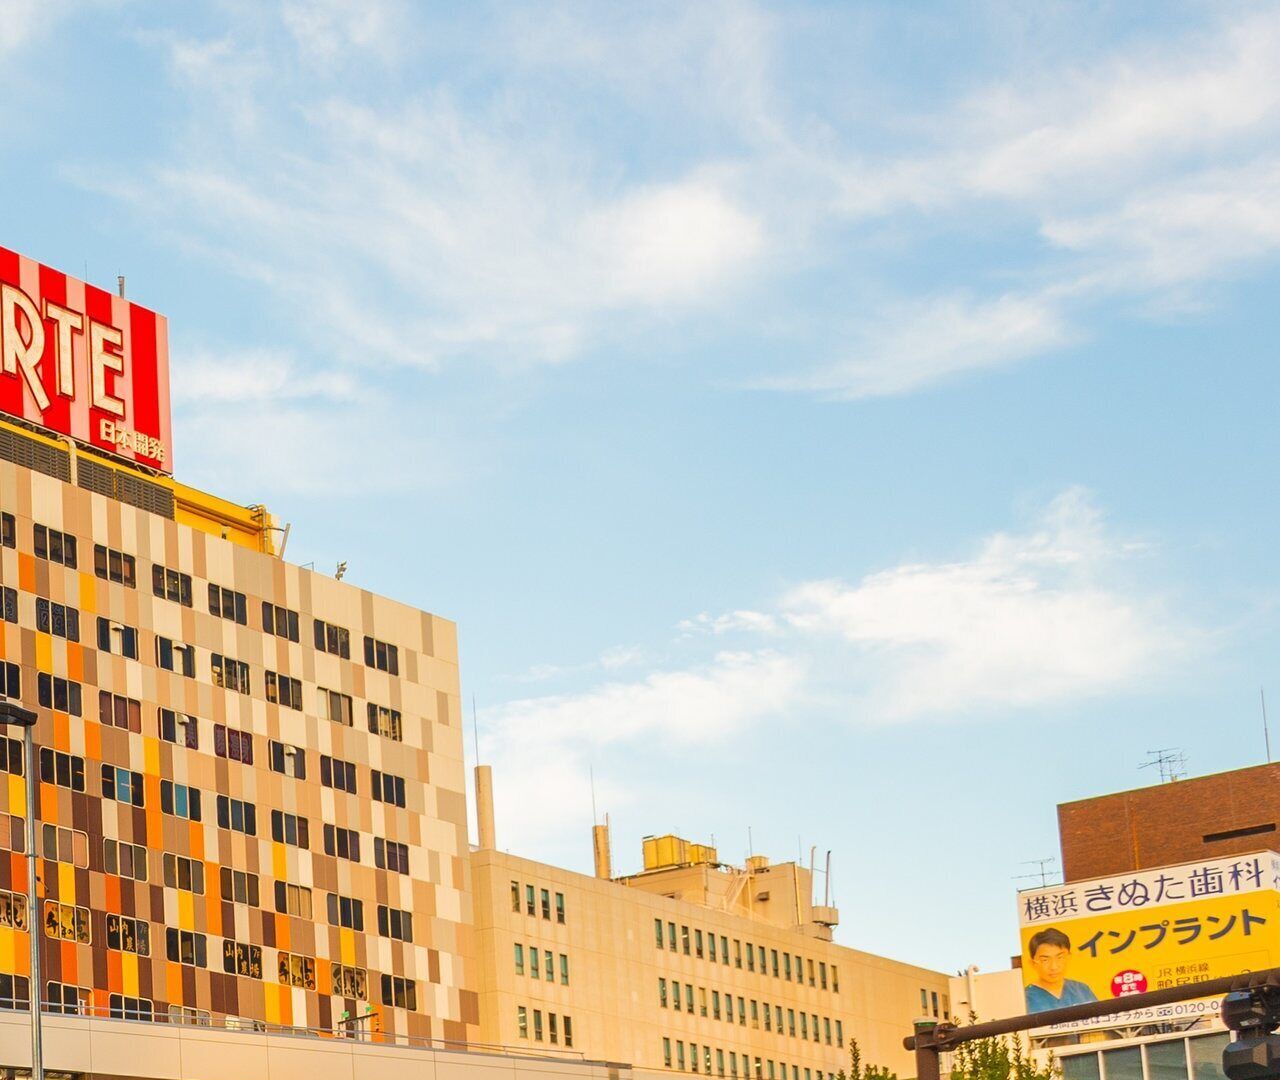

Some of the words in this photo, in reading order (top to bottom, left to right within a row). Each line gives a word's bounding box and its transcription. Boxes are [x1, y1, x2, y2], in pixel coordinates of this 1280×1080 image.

[98, 418, 167, 464] 日本開発
[1024, 890, 1079, 921] 横浜
[1084, 858, 1265, 913] きぬた歯科
[1077, 907, 1268, 958] インプラント
[1157, 967, 1173, 979] JR
